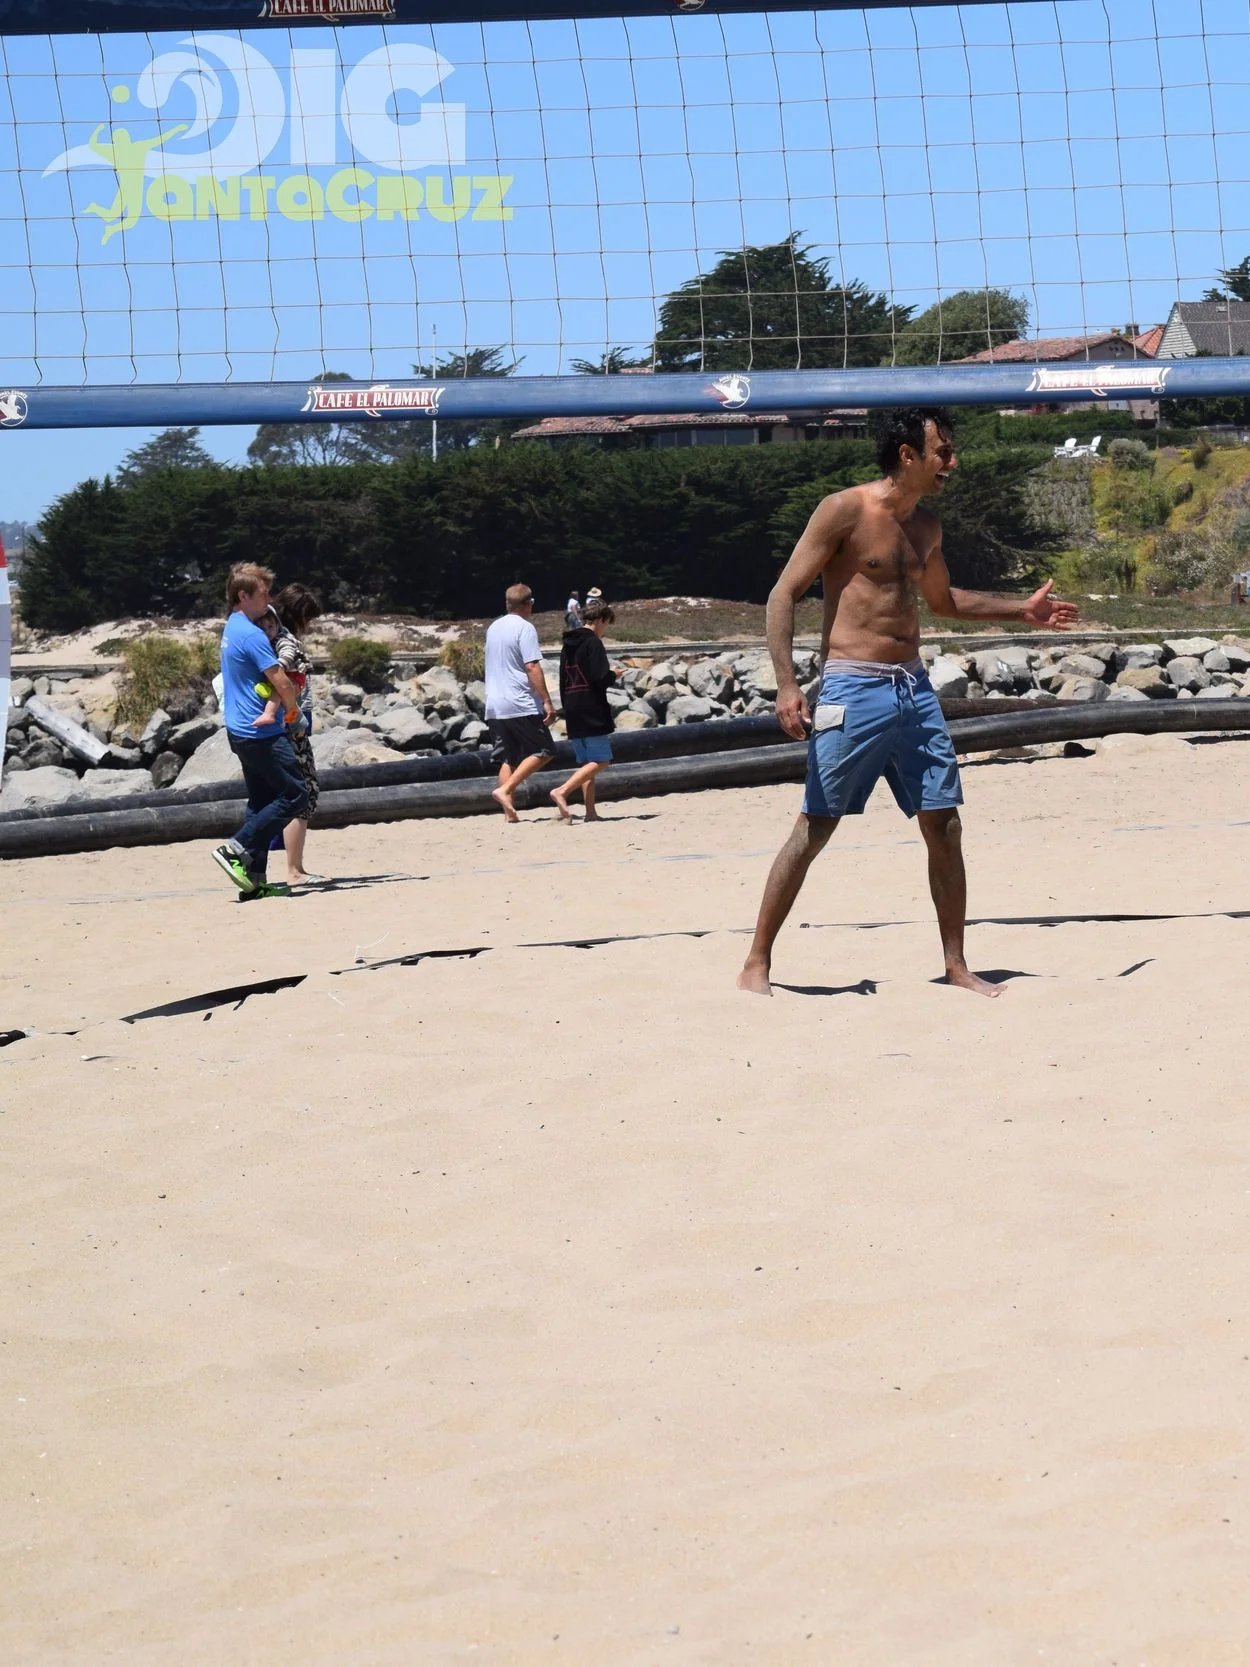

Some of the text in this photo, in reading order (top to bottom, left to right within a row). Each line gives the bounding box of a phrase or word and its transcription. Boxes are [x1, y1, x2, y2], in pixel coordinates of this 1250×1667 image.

[274, 0, 385, 14] CAFE EL PALOMAR
[319, 391, 429, 408] CAFE EL PALOMAR
